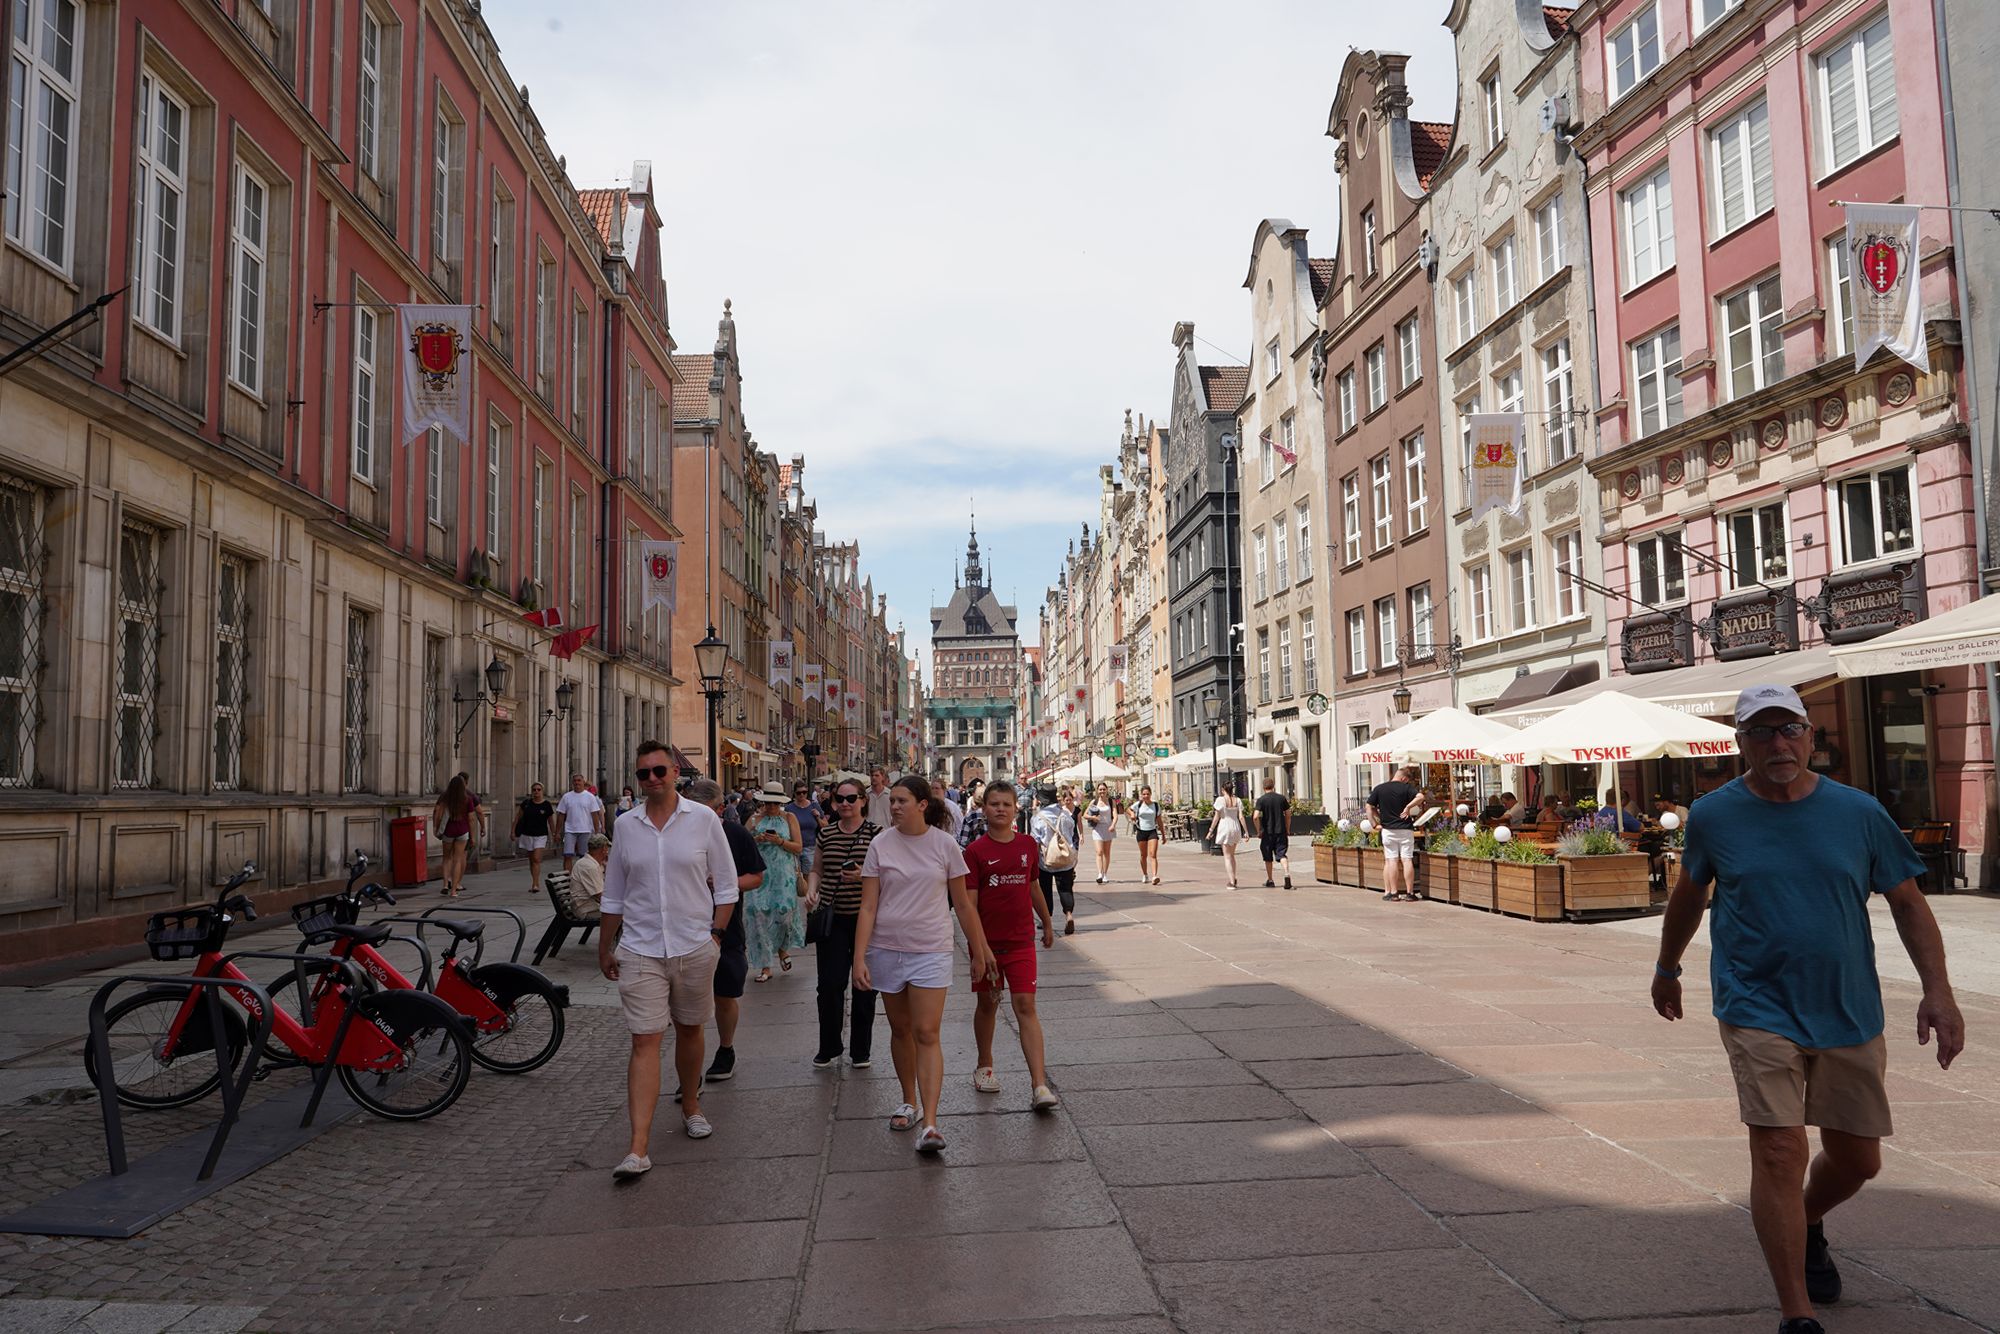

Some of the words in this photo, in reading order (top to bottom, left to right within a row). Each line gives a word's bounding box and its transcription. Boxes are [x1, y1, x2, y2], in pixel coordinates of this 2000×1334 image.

[1831, 590, 1900, 616] RESTAURANT
[1721, 611, 1772, 638] NAPOLI
[1900, 644, 1955, 657] MILLENNIUM
[1958, 639, 2000, 650] GALLERY
[1432, 748, 1478, 761] TYSKIE
[1571, 745, 1632, 761] TYSKIE
[1686, 740, 1732, 756] TYSKIE
[1361, 751, 1393, 763] TYSKIE
[1503, 752, 1525, 764] SKIE
[1194, 762, 1224, 771] STARBUKS
[483, 987, 498, 1001] 1451
[375, 1017, 395, 1037] 0406
